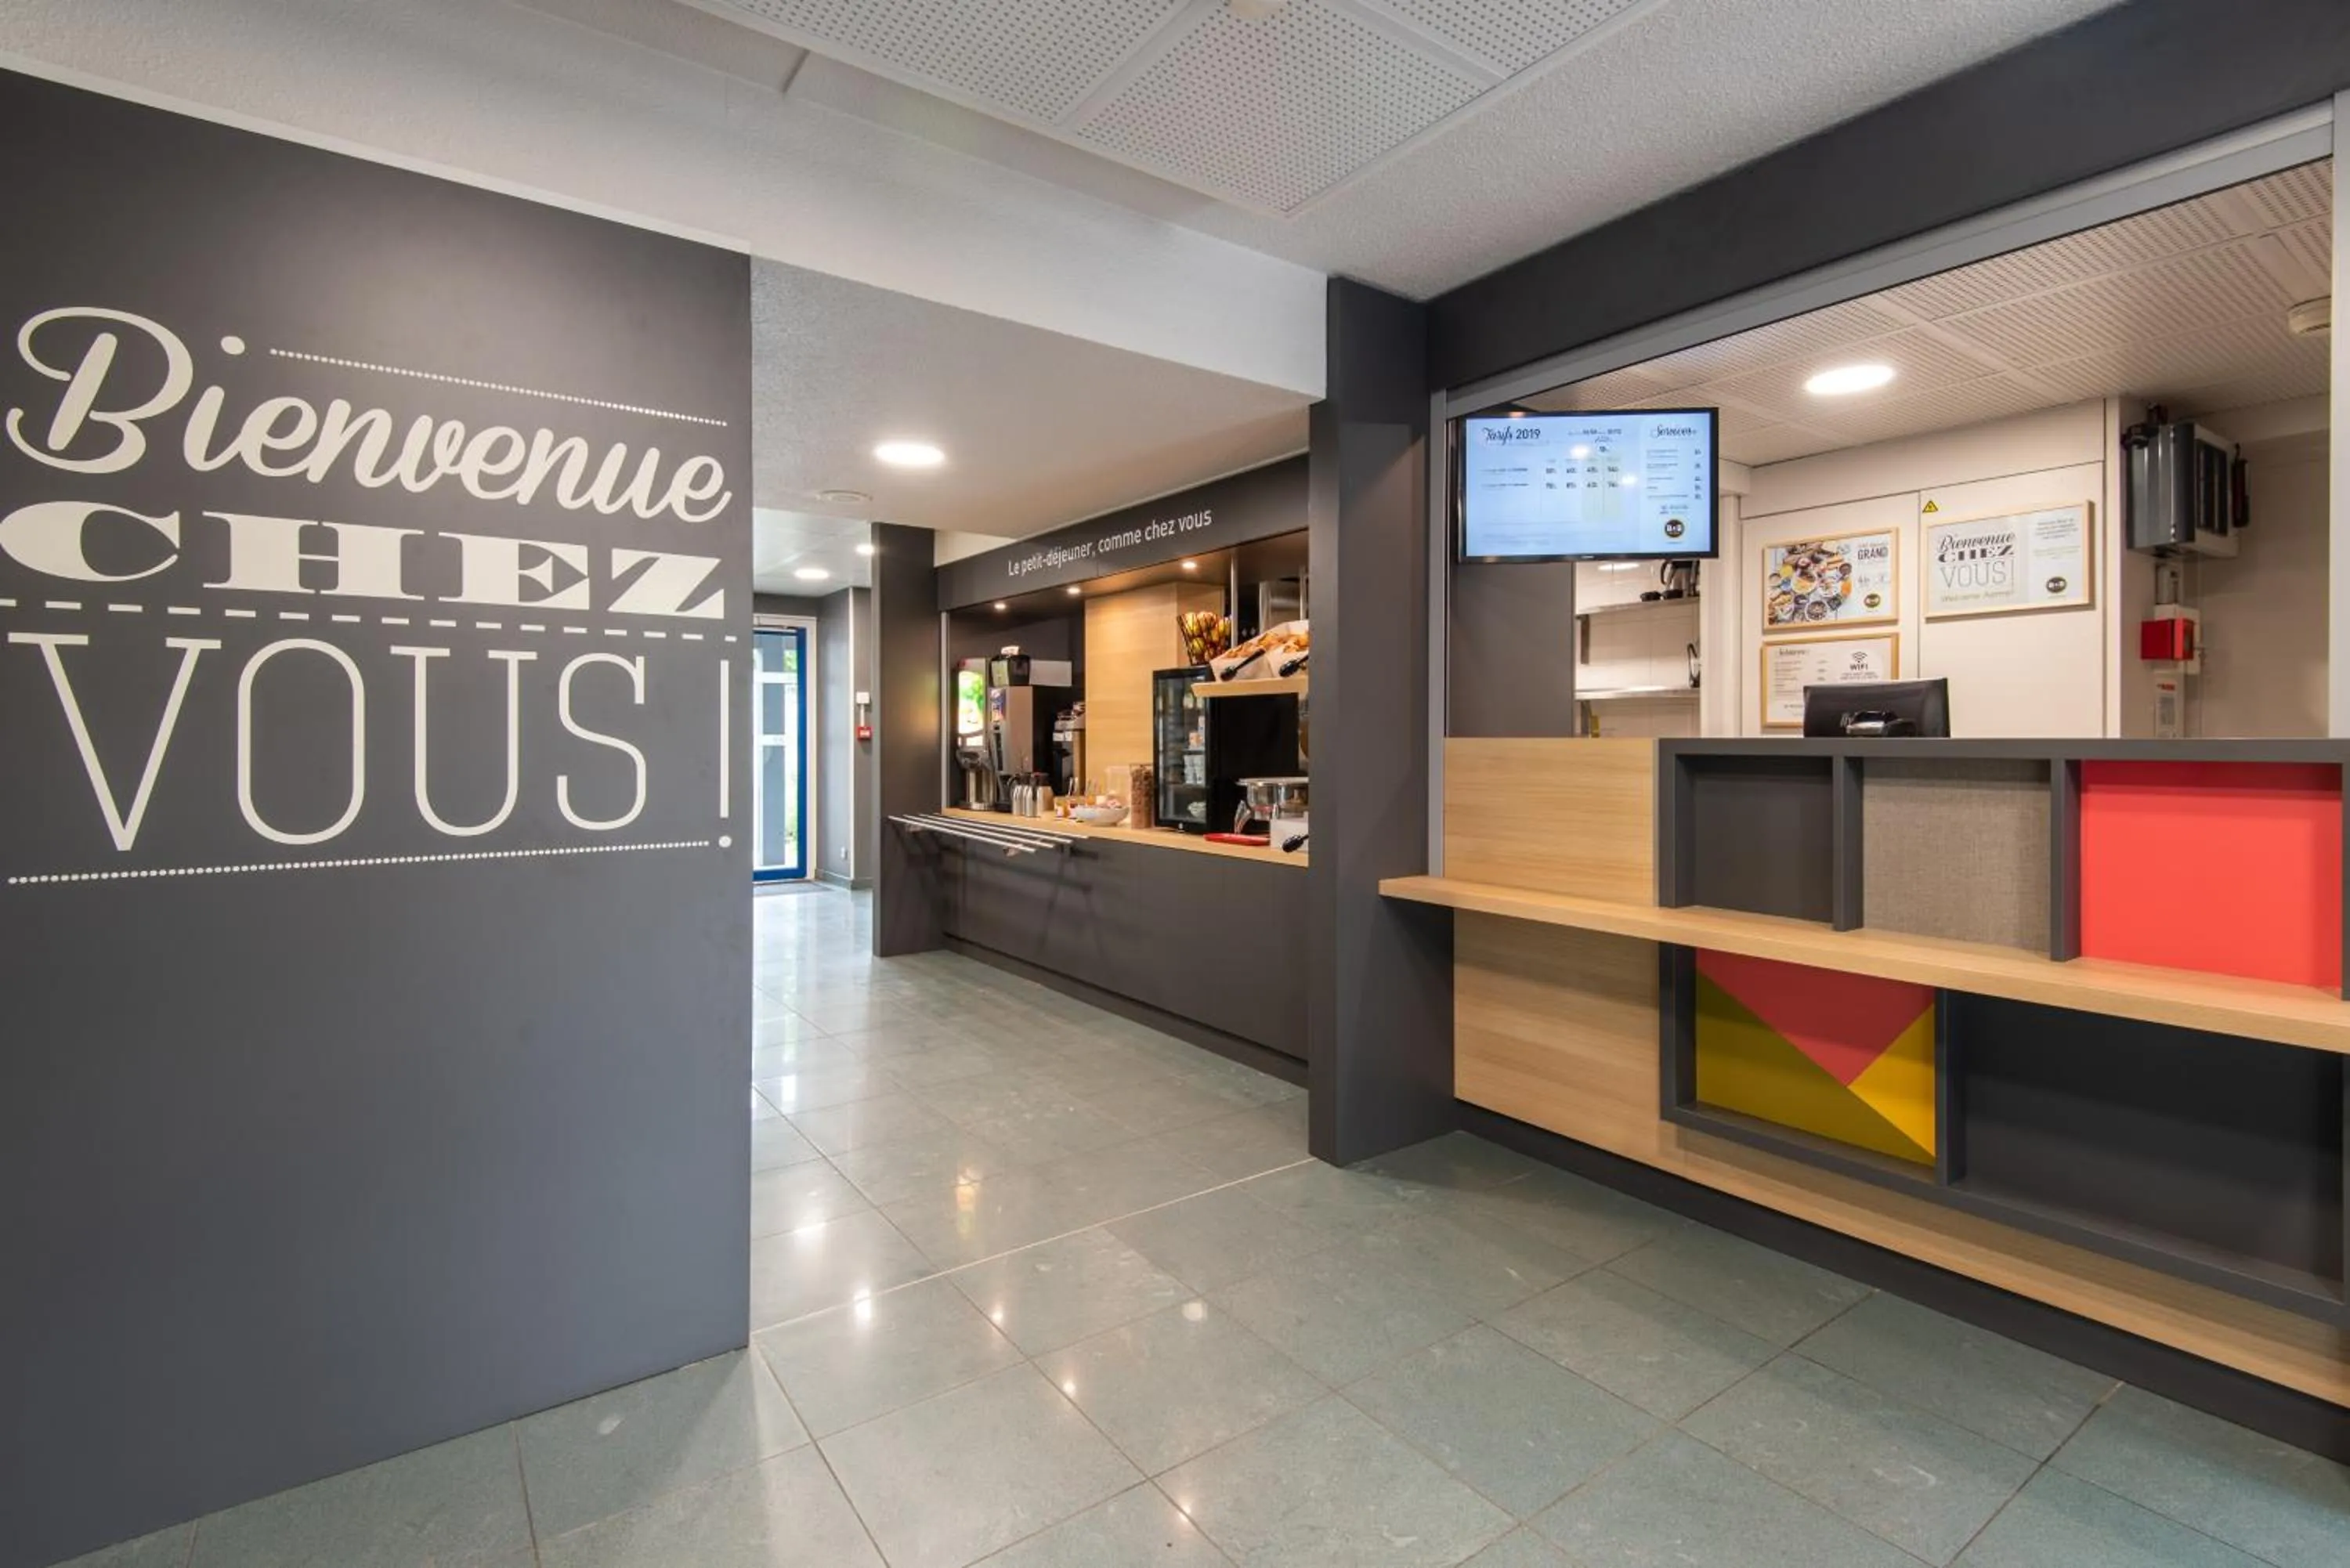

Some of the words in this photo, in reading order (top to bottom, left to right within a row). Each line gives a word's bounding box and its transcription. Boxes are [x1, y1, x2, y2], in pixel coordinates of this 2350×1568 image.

[6, 306, 732, 523] Bienvenue
[1516, 428, 1541, 439] 2019
[0, 501, 725, 619] CHEZ
[1008, 558, 1020, 576] Le
[1097, 529, 1141, 553] comme
[1144, 519, 1176, 541] chez
[1178, 509, 1213, 533] vous
[1938, 544, 2015, 563] CHEZ
